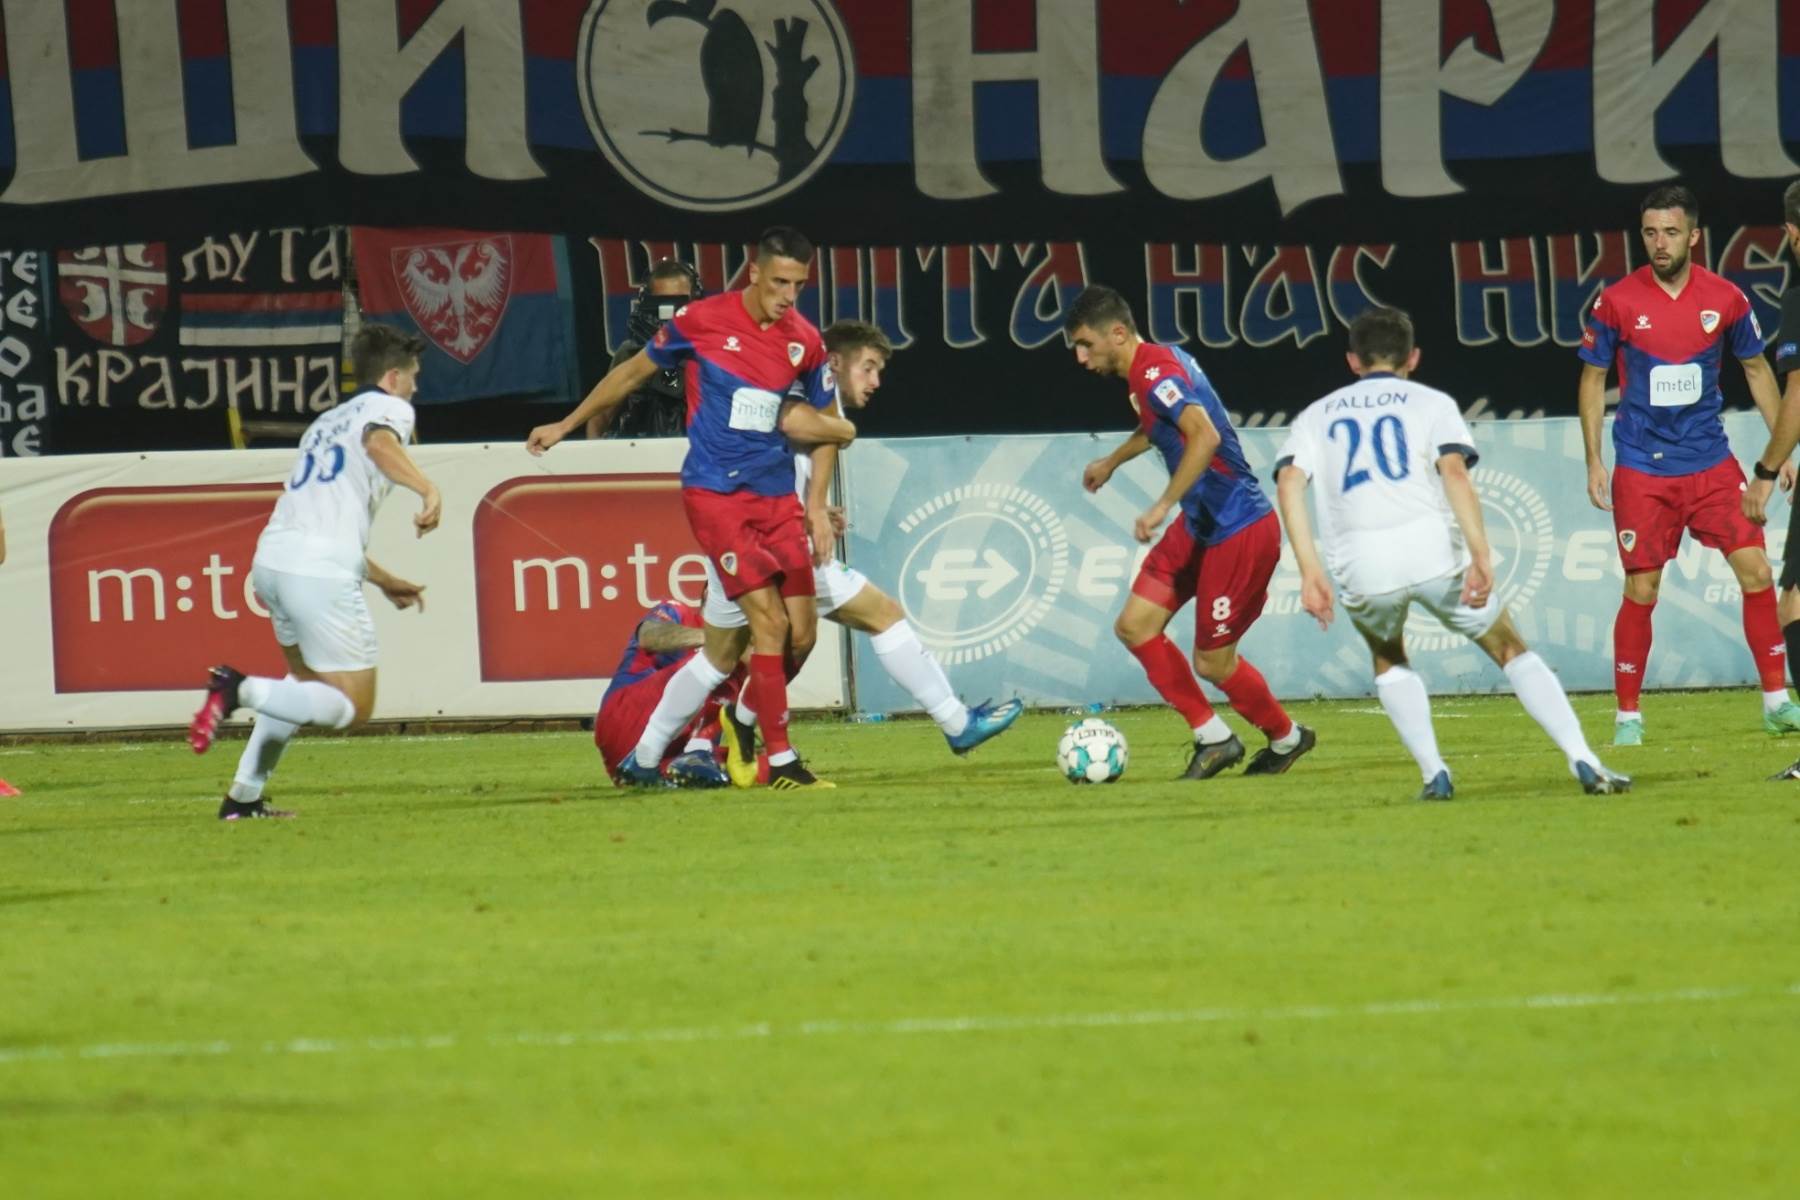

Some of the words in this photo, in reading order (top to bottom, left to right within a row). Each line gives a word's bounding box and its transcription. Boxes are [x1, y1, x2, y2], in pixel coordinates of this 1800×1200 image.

[55, 346, 341, 413] КРАЈИНА
[1656, 375, 1697, 393] m:tel
[1324, 392, 1408, 414] FALLON
[1328, 415, 1410, 495] 20
[513, 543, 709, 612] m:te
[1212, 596, 1232, 621] 8
